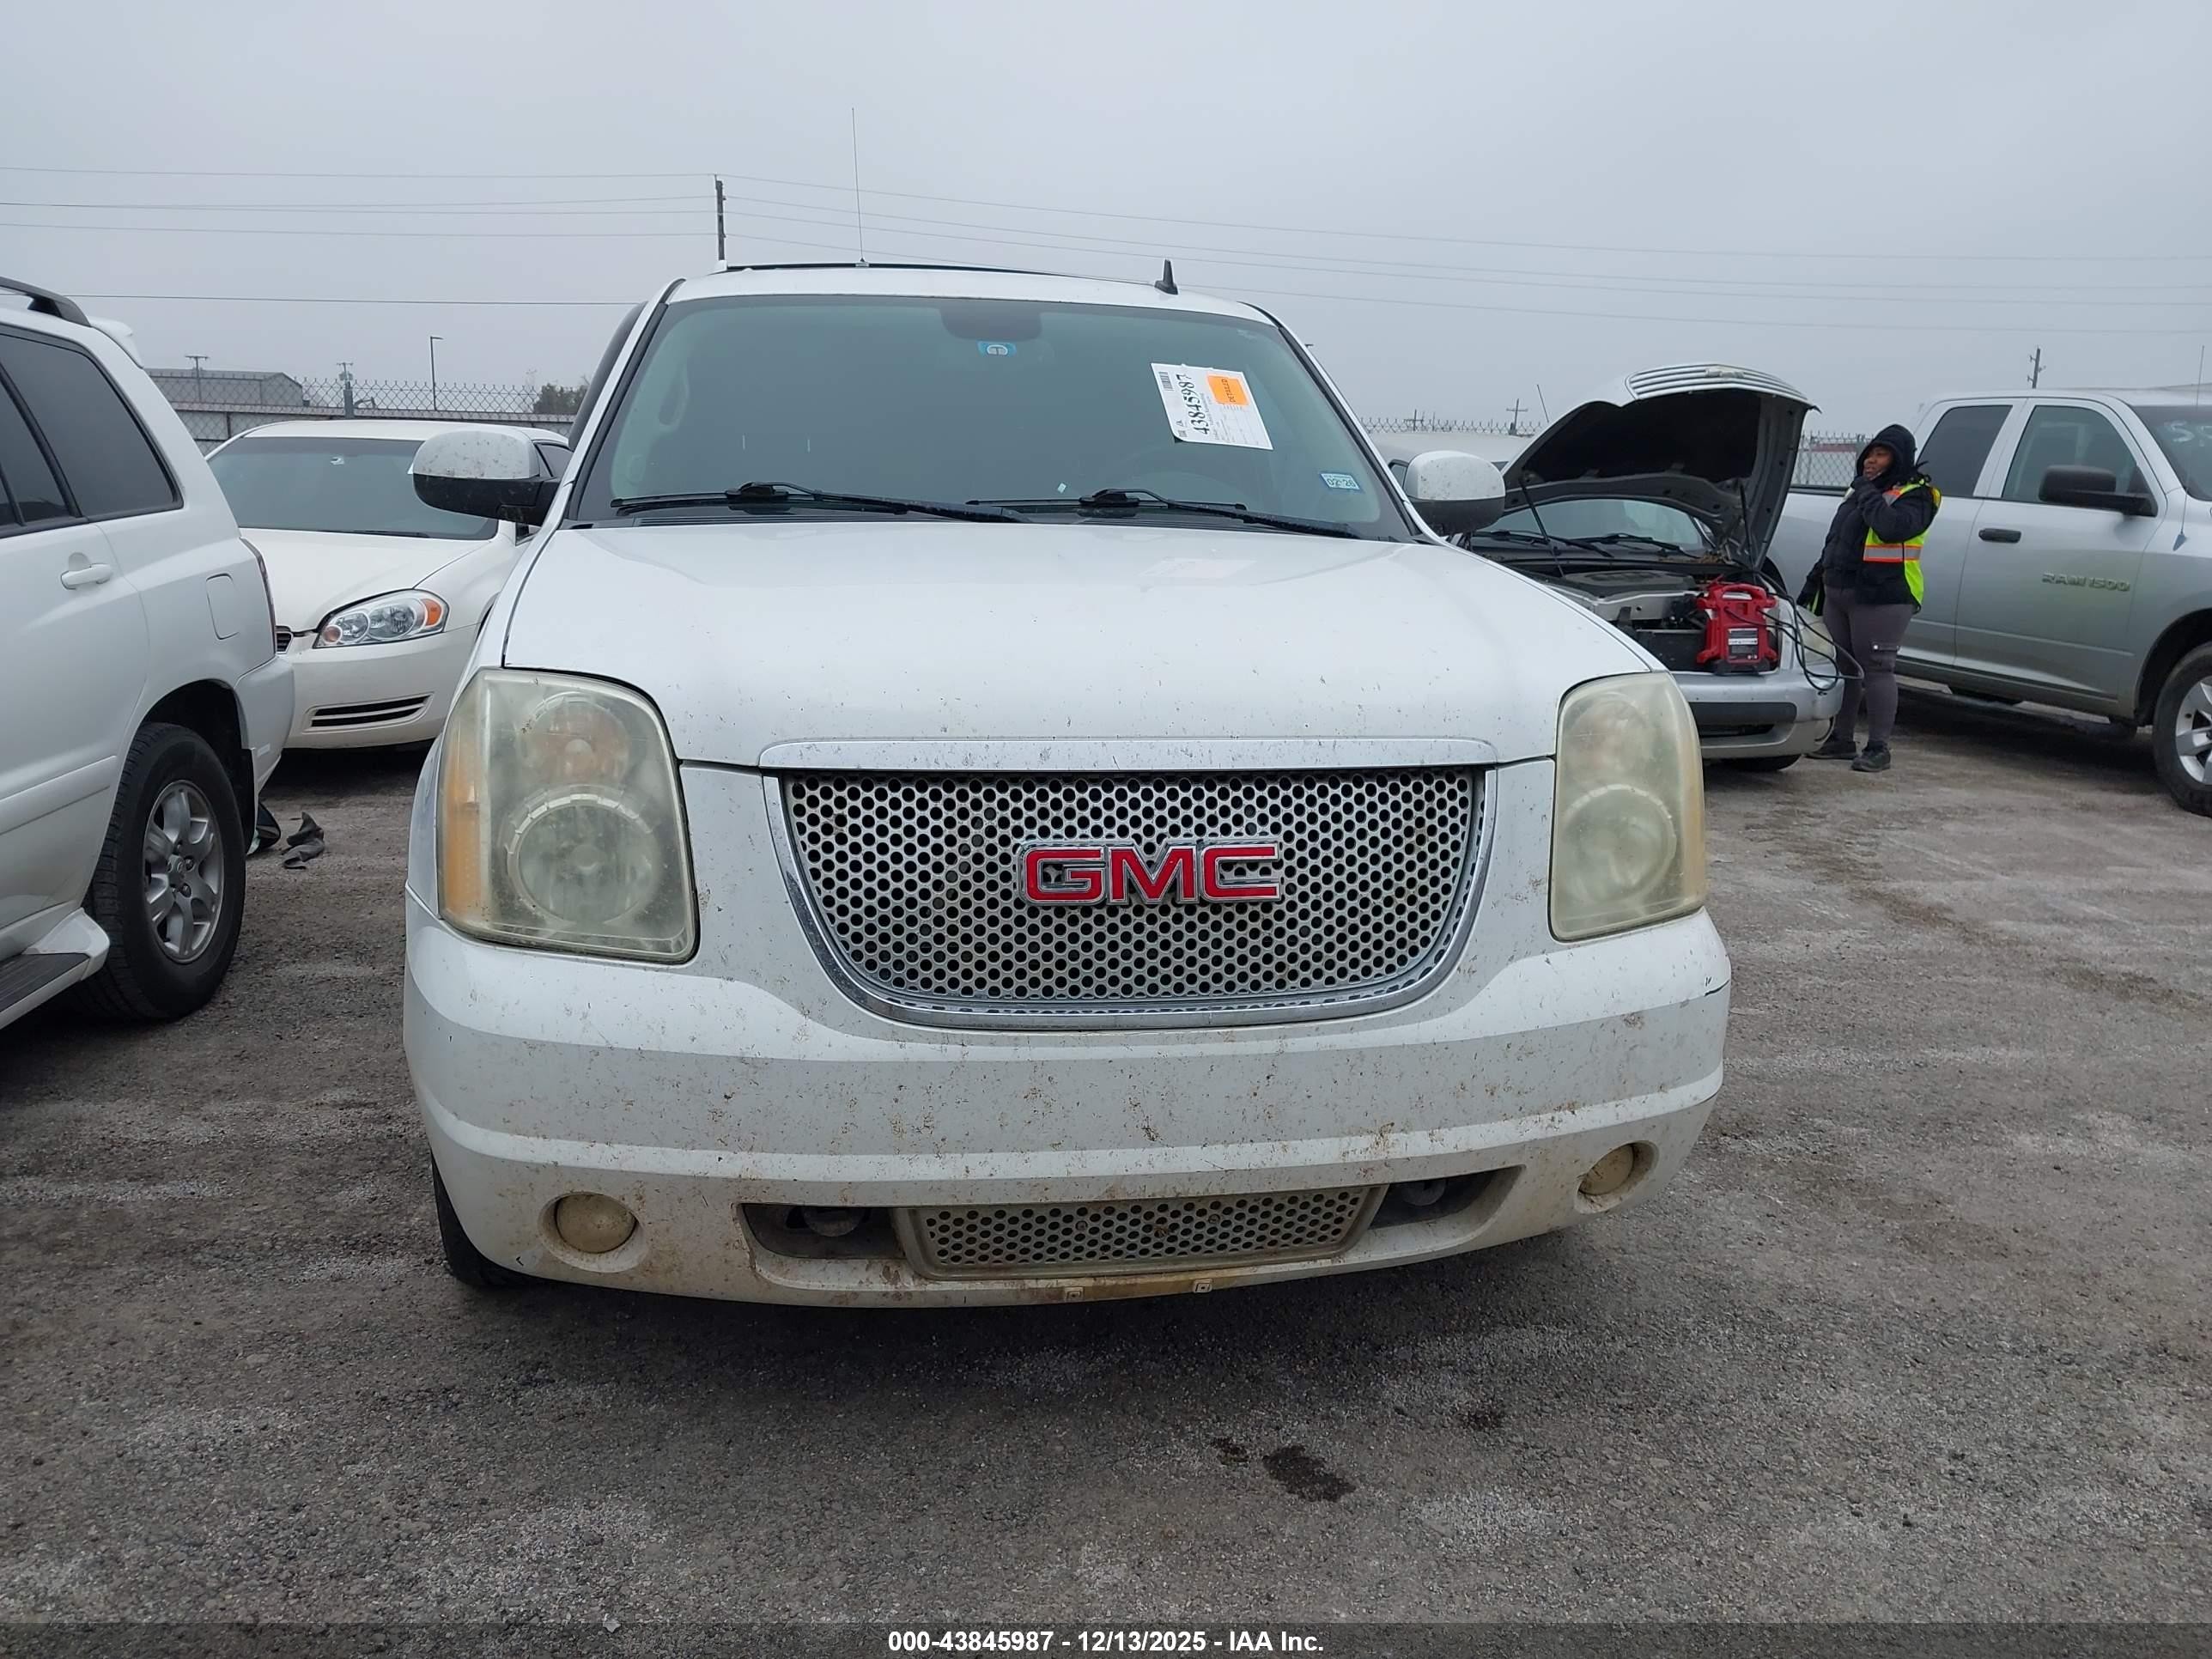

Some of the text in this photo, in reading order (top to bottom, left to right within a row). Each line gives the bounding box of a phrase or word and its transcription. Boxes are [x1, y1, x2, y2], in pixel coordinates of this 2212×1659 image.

[1176, 374, 1210, 435] 43845987
[1221, 379, 1237, 403] DETAILED
[2042, 573, 2130, 592] RAM 1500
[1018, 841, 1282, 904] GMC
